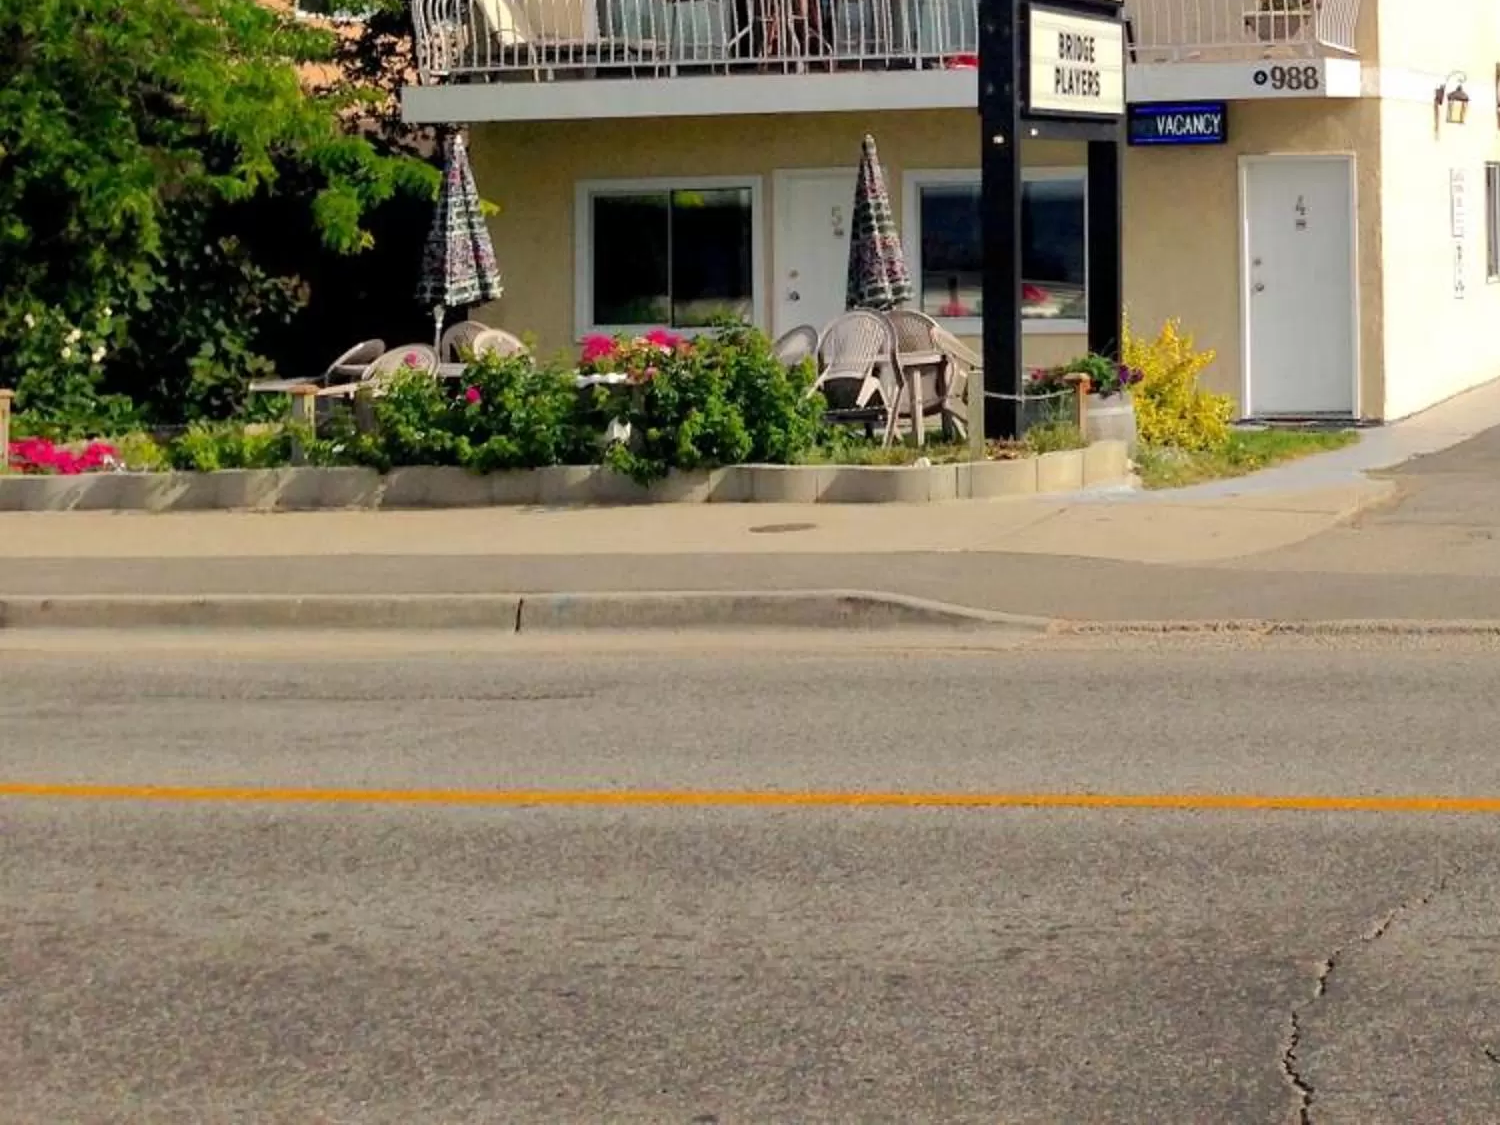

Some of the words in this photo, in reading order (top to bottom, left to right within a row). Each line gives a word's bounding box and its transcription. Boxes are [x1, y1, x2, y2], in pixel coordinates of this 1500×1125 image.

[1058, 32, 1095, 62] BRIDGE
[1055, 67, 1100, 97] PLAYERS
[1271, 66, 1319, 91] 988
[1156, 113, 1222, 136] VACANCY
